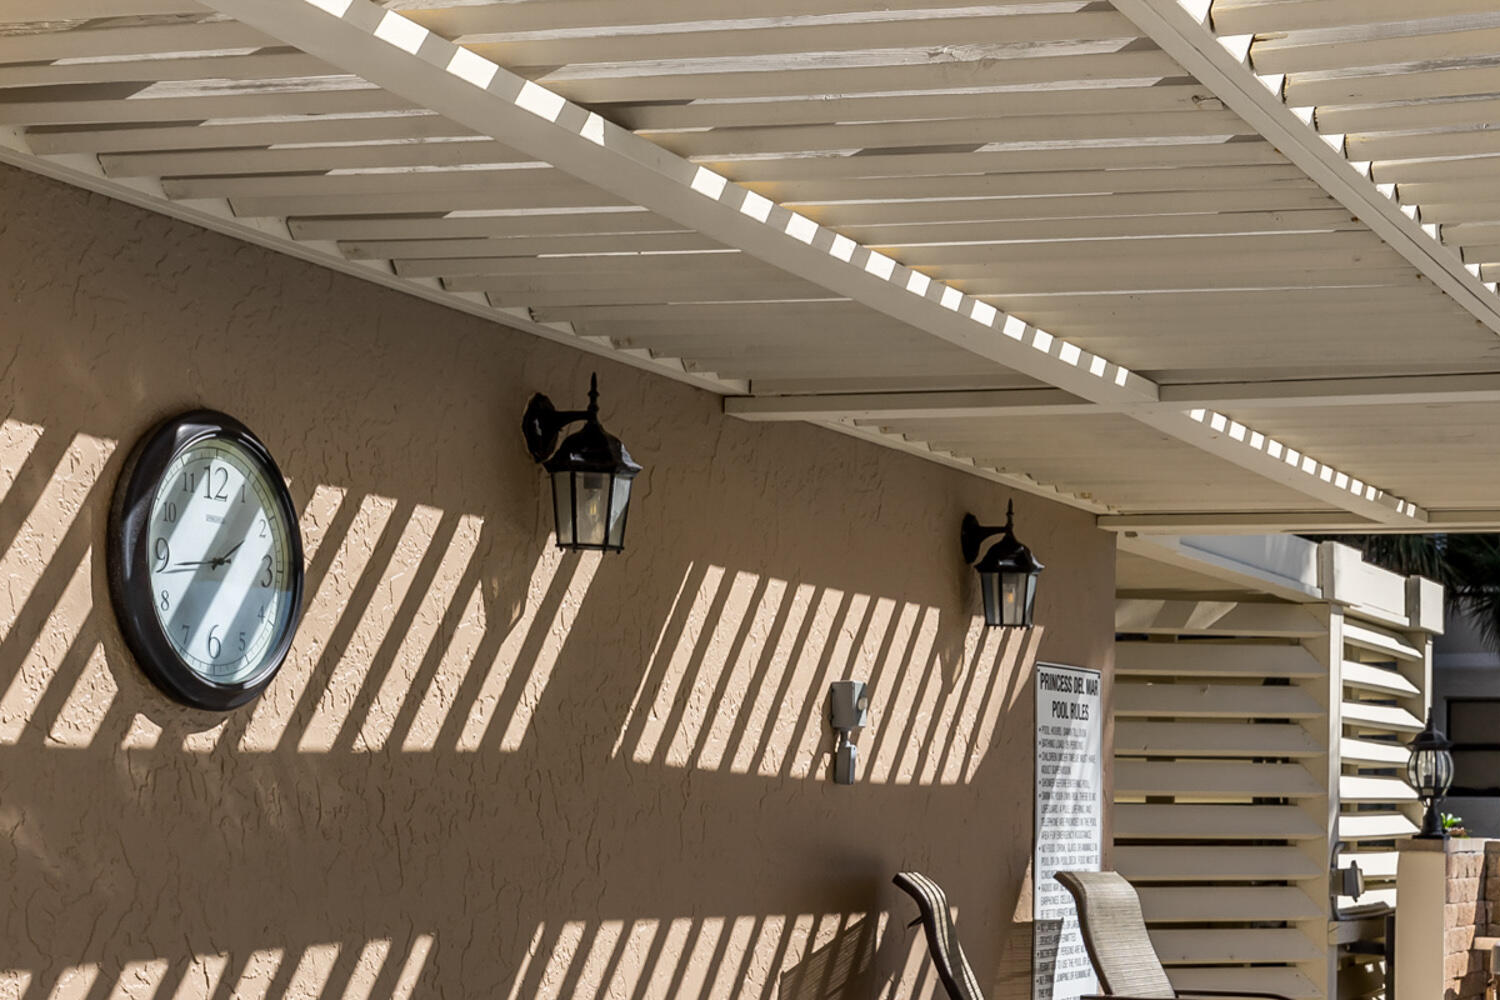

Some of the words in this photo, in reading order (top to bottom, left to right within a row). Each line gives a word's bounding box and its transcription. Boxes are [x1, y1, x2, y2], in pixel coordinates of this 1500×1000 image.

[183, 472, 195, 493] 11
[203, 465, 229, 502] 12
[241, 484, 246, 504] 1
[163, 502, 177, 523] 10
[259, 519, 267, 538] 2
[155, 537, 170, 573] 9
[261, 554, 273, 588] 3
[161, 590, 170, 611] 8
[258, 606, 265, 624] 4
[182, 624, 190, 645] 7
[208, 624, 221, 659] 6
[239, 632, 246, 652] 5
[1040, 672, 1072, 693] PRINCESS
[1074, 676, 1085, 694] DEL
[1086, 679, 1098, 696] MAR
[1052, 700, 1069, 719] POOL
[1070, 702, 1089, 720] RULES
